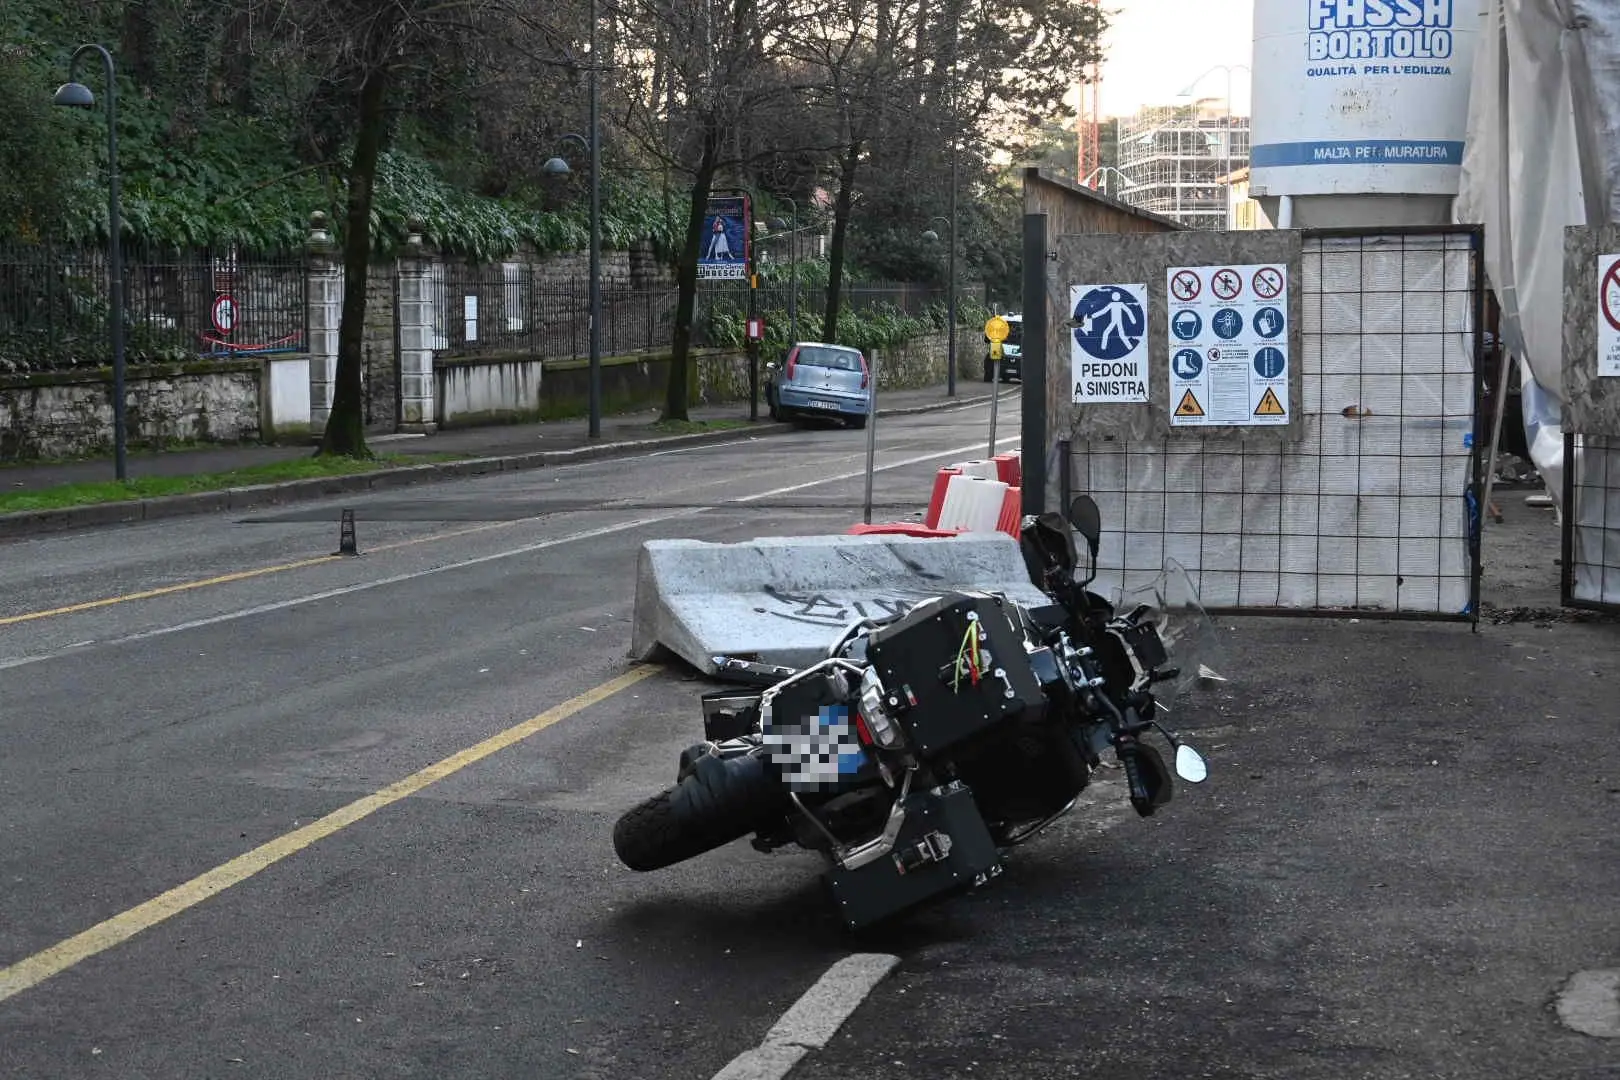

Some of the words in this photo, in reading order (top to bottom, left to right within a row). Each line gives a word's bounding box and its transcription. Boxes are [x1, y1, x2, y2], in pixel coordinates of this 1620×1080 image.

[1309, 0, 1453, 30] FASSA
[1309, 29, 1452, 60] BORTOLO
[1364, 65, 1389, 74] PER
[1393, 65, 1452, 75] L'EDILIZIA
[1314, 147, 1351, 160] MALTA
[1384, 145, 1448, 158] MURATURA
[1081, 362, 1138, 378] PEDONI
[1074, 381, 1083, 396] A
[1086, 380, 1146, 396] SINISTRA
